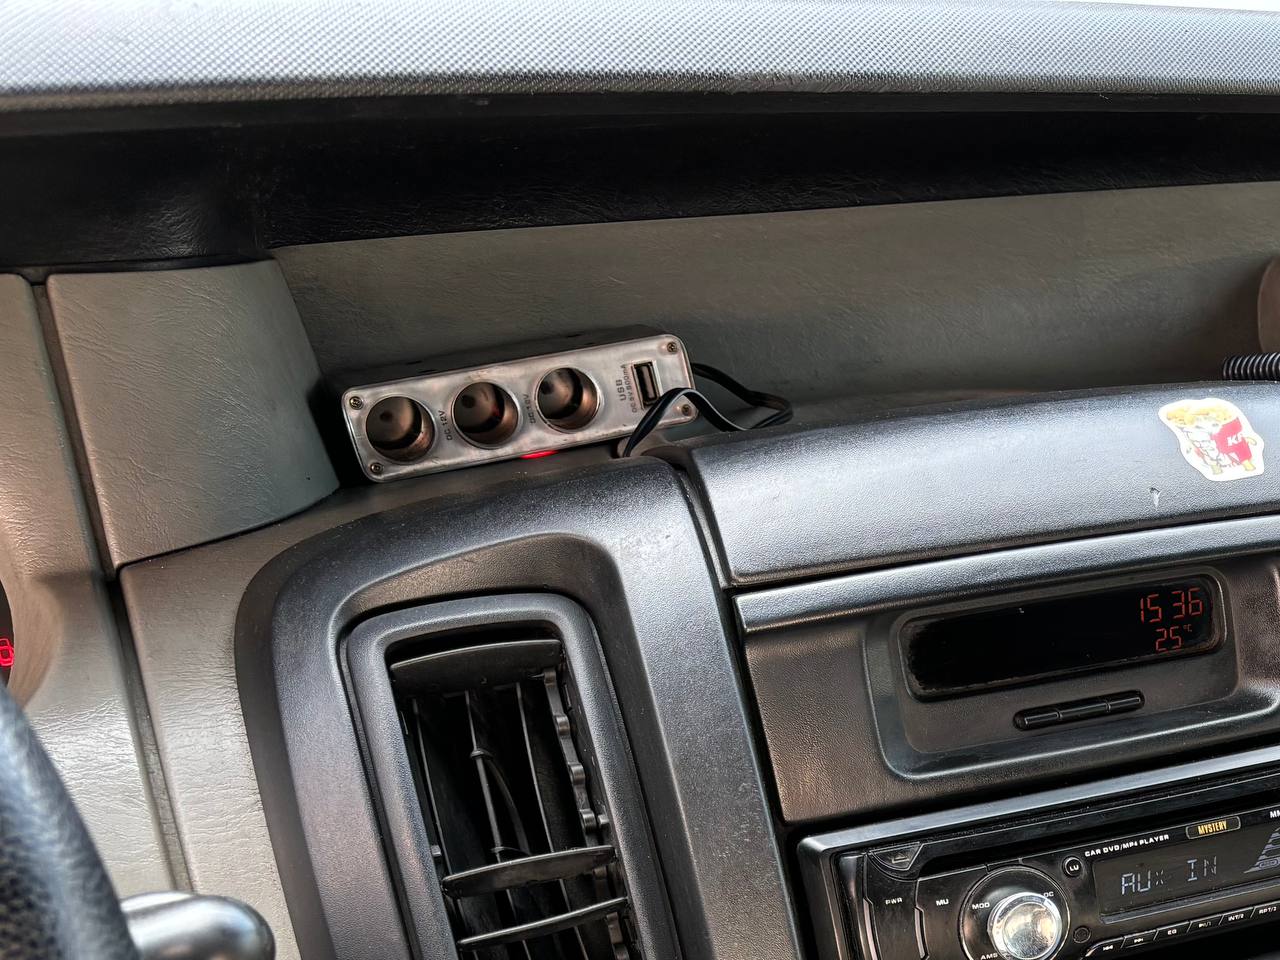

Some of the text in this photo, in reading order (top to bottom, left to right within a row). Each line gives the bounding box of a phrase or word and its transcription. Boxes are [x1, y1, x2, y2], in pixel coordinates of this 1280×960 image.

[615, 379, 627, 401] USB
[438, 410, 453, 441] DC 12V
[1197, 819, 1228, 837] MYSTERY
[1084, 834, 1170, 858] CAR DVD/MP4 PLAYER
[1186, 856, 1218, 882] IN
[885, 897, 903, 905] PWR
[972, 902, 991, 910] MOD
[980, 952, 999, 960] AMS
